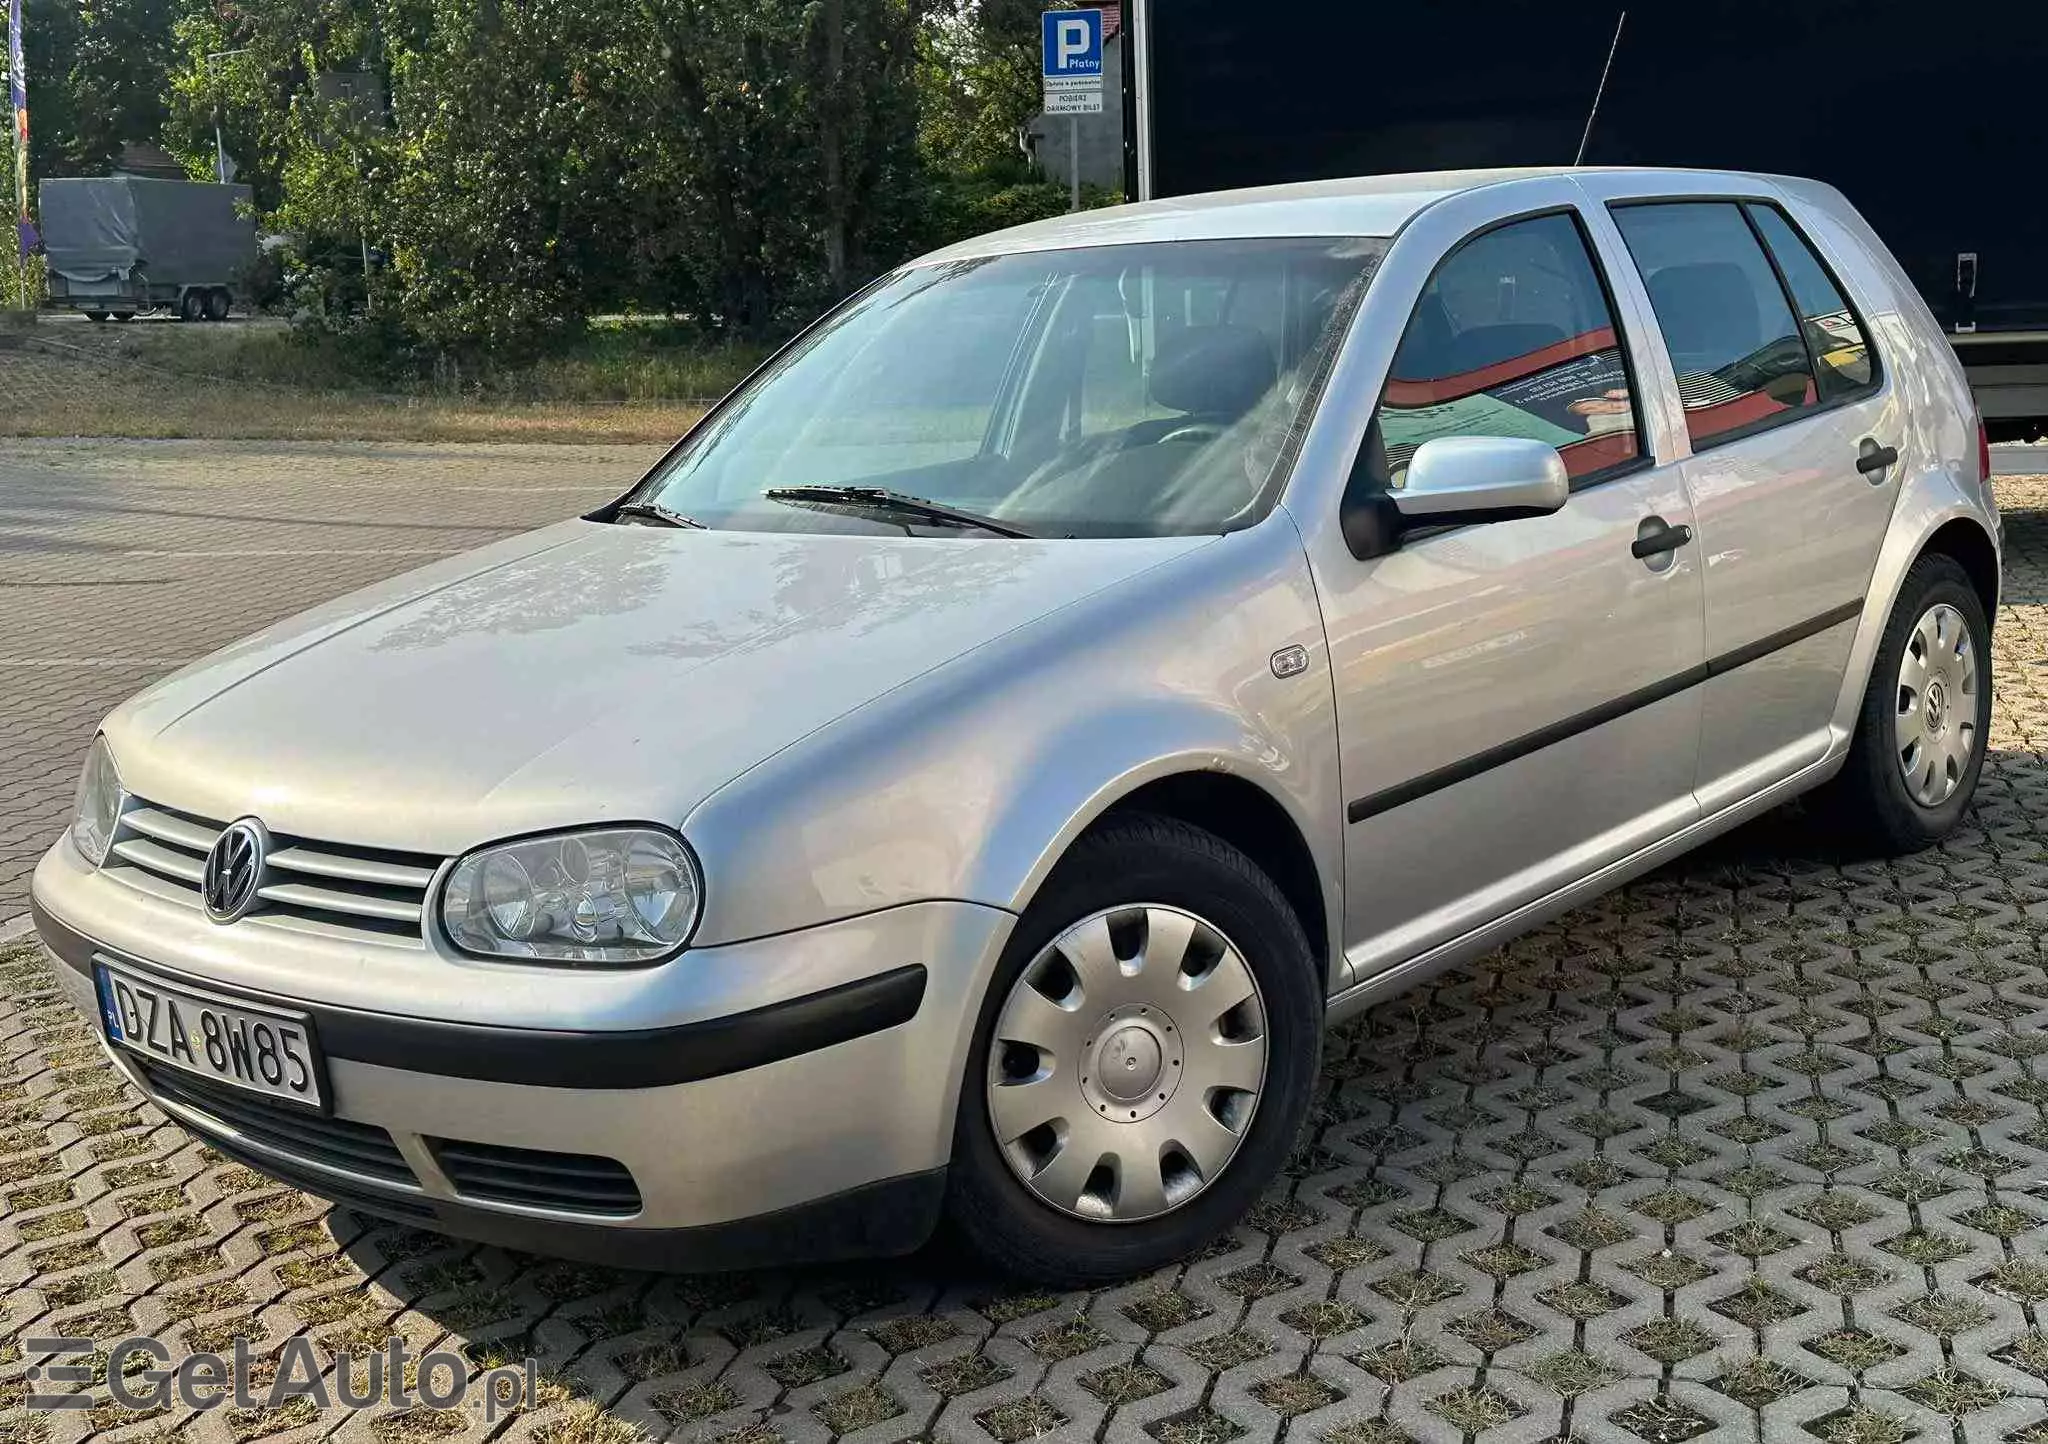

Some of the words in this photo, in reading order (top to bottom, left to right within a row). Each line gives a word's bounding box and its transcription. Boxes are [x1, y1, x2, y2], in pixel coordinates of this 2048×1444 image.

[1057, 19, 1090, 69] P
[1069, 59, 1100, 70] Płatny
[114, 979, 197, 1066] DZA
[200, 1008, 310, 1093] 8W85
